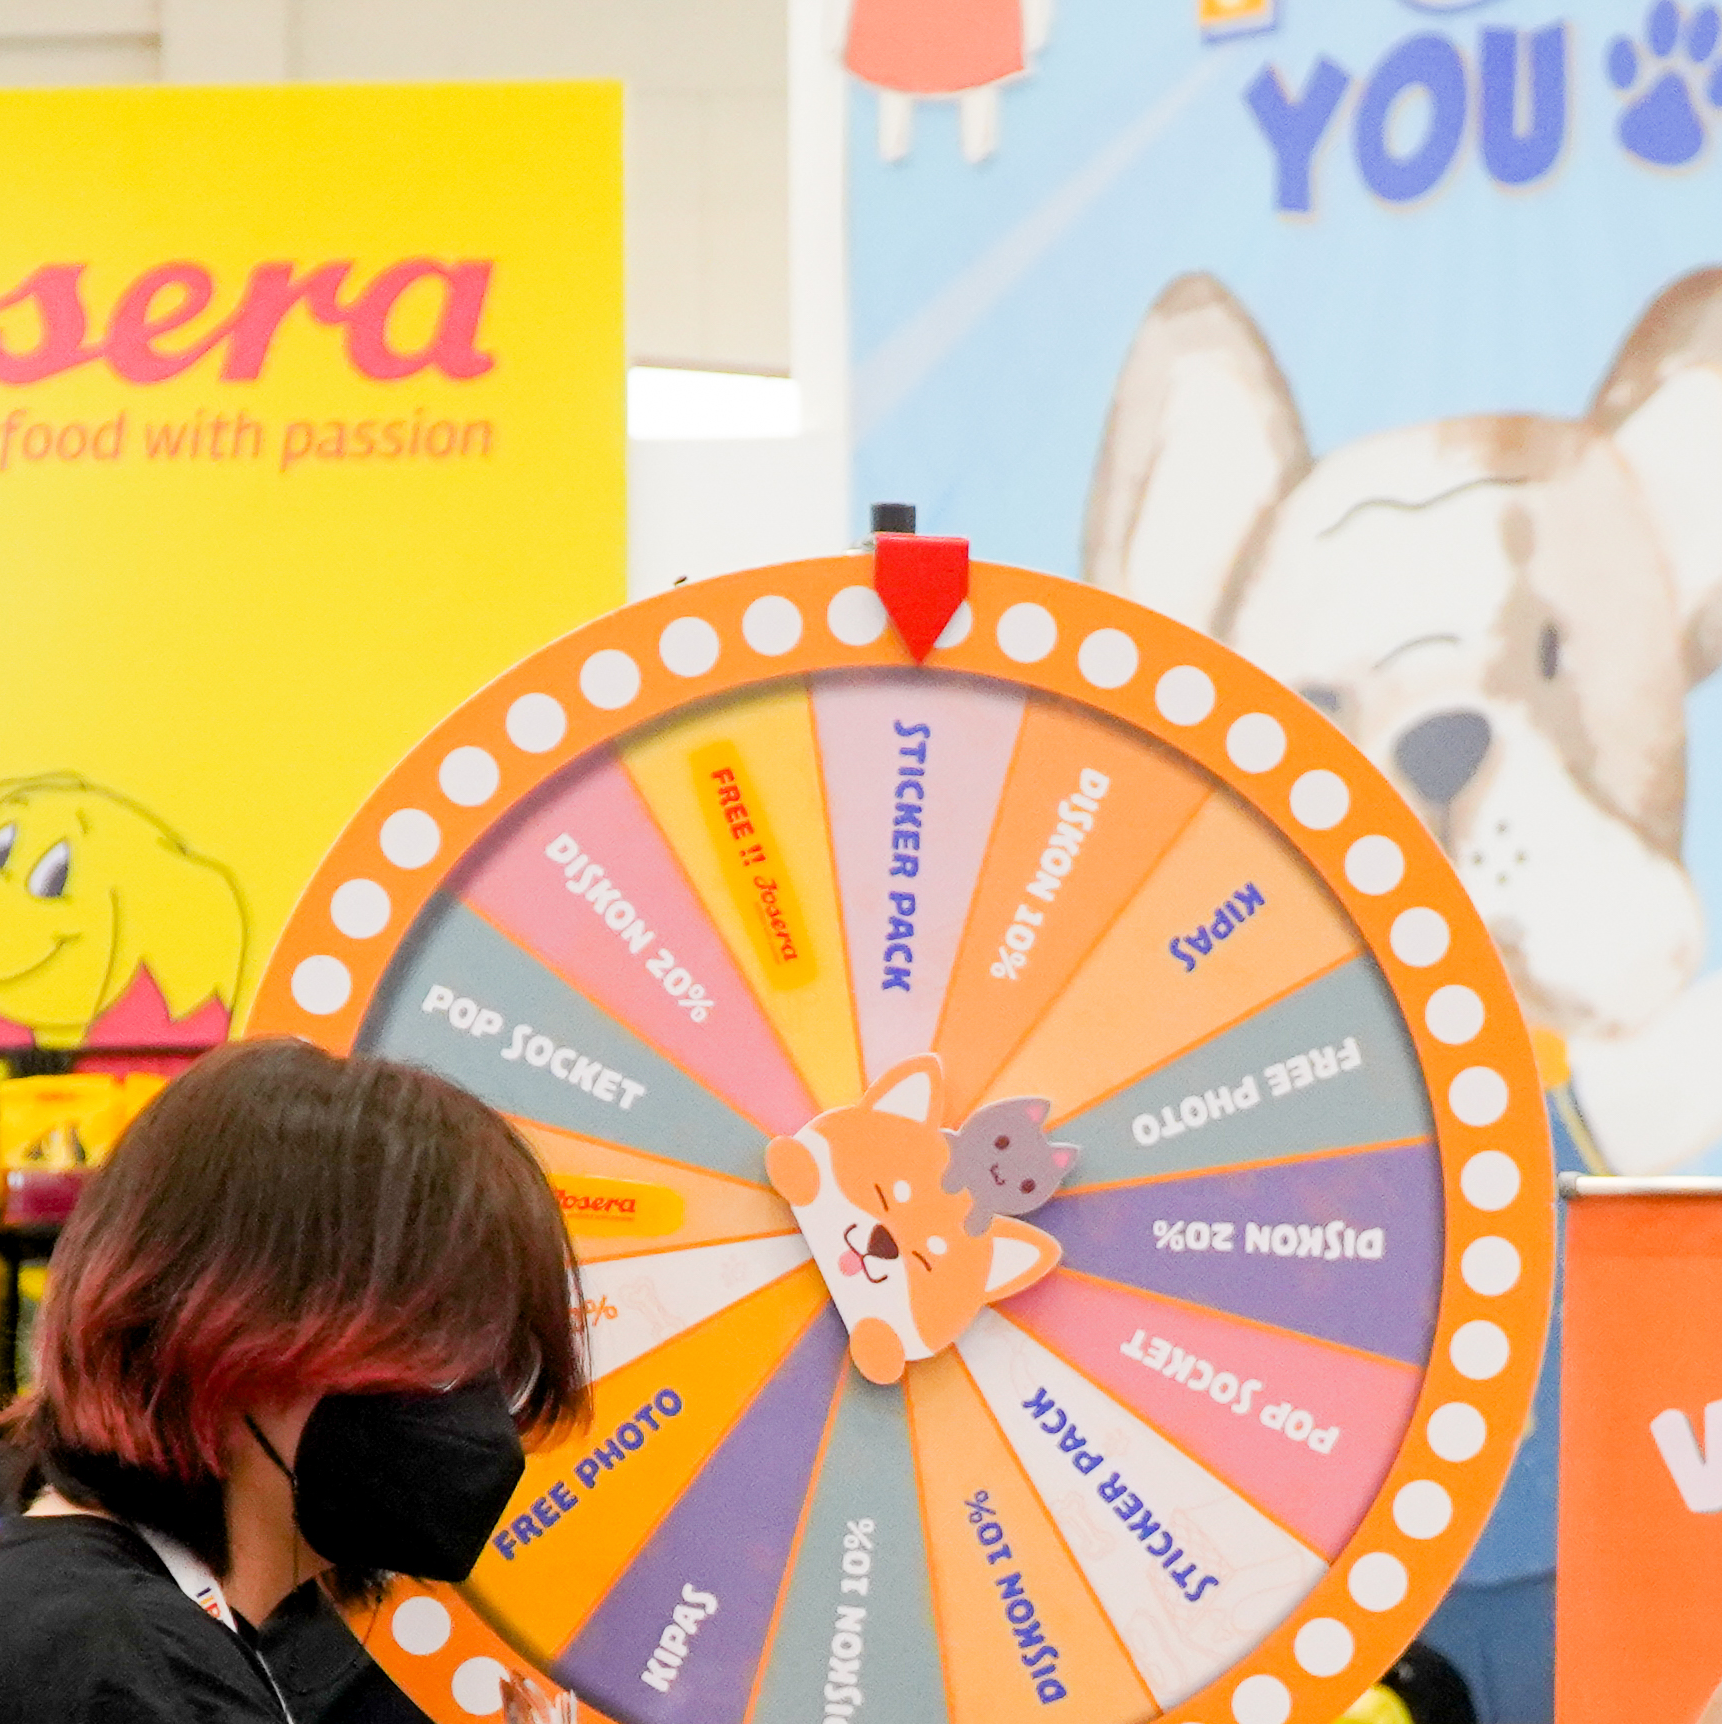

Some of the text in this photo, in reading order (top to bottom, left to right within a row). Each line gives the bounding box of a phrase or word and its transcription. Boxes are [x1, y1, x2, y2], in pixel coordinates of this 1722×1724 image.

[1242, 20, 1569, 213] YOU
[144, 408, 262, 459] with
[280, 410, 494, 472] passion
[710, 767, 756, 840] FREE
[739, 845, 766, 867] !!
[882, 718, 931, 992] STICKER PACK
[545, 832, 715, 1024] DISKON 20%
[751, 875, 798, 963] Josera
[990, 768, 1110, 981] DISKON 10%
[1169, 881, 1266, 973] KIPAS
[421, 984, 647, 1111] POP SOCKET
[1132, 1036, 1363, 1147] FREE PHOTO
[1153, 1219, 1384, 1259] DISKON 20%
[1120, 1328, 1340, 1455] POP SOCKET
[491, 1387, 684, 1561] FREE PHOTO
[1022, 1386, 1220, 1602] STICKER PACK
[841, 1516, 875, 1595] 10%
[963, 1489, 1068, 1704] DISKON 10%
[640, 1582, 718, 1693] KIPAS
